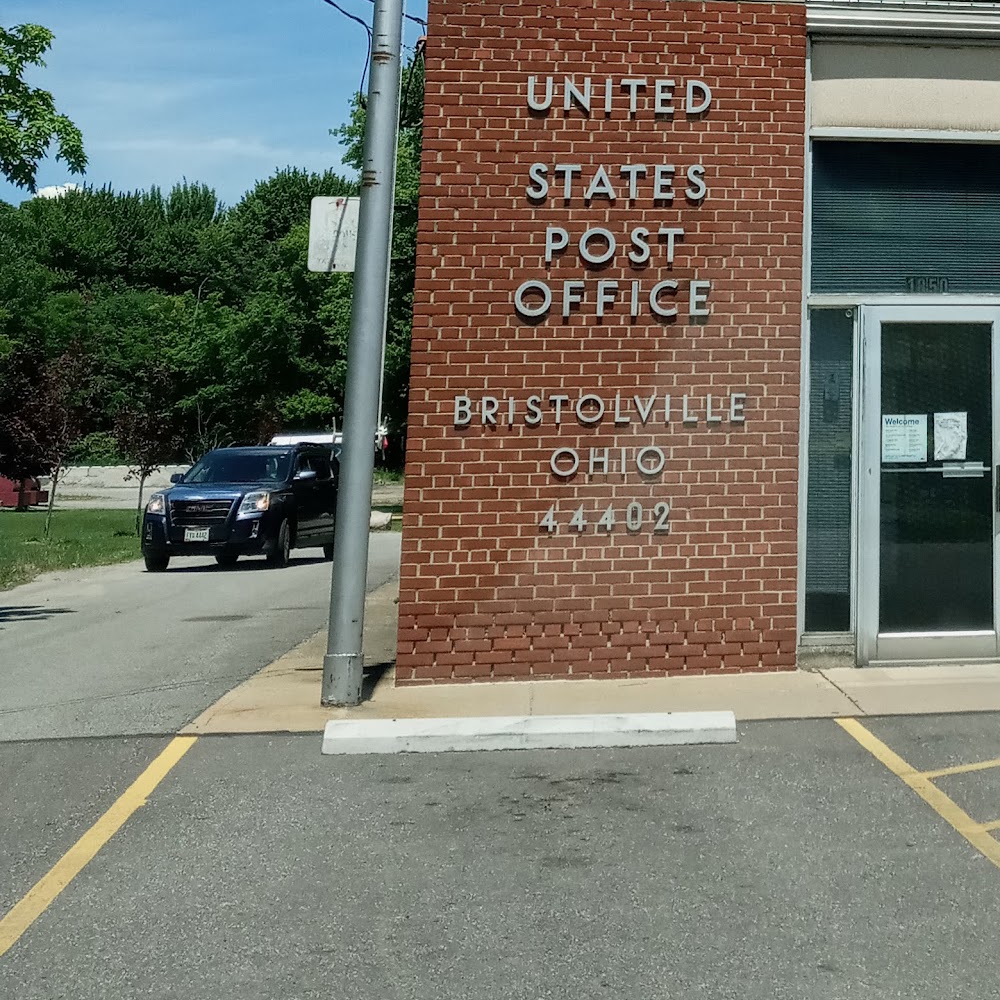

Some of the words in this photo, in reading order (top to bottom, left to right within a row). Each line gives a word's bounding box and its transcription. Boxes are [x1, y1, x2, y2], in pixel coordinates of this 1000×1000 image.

[526, 75, 712, 114] UNITED
[526, 163, 708, 200] STATES
[545, 226, 685, 264] POST
[514, 280, 711, 317] OFFICE
[453, 393, 746, 425] BRISTOLVILLE
[551, 446, 665, 477] OHIO
[539, 501, 670, 532] 44402
